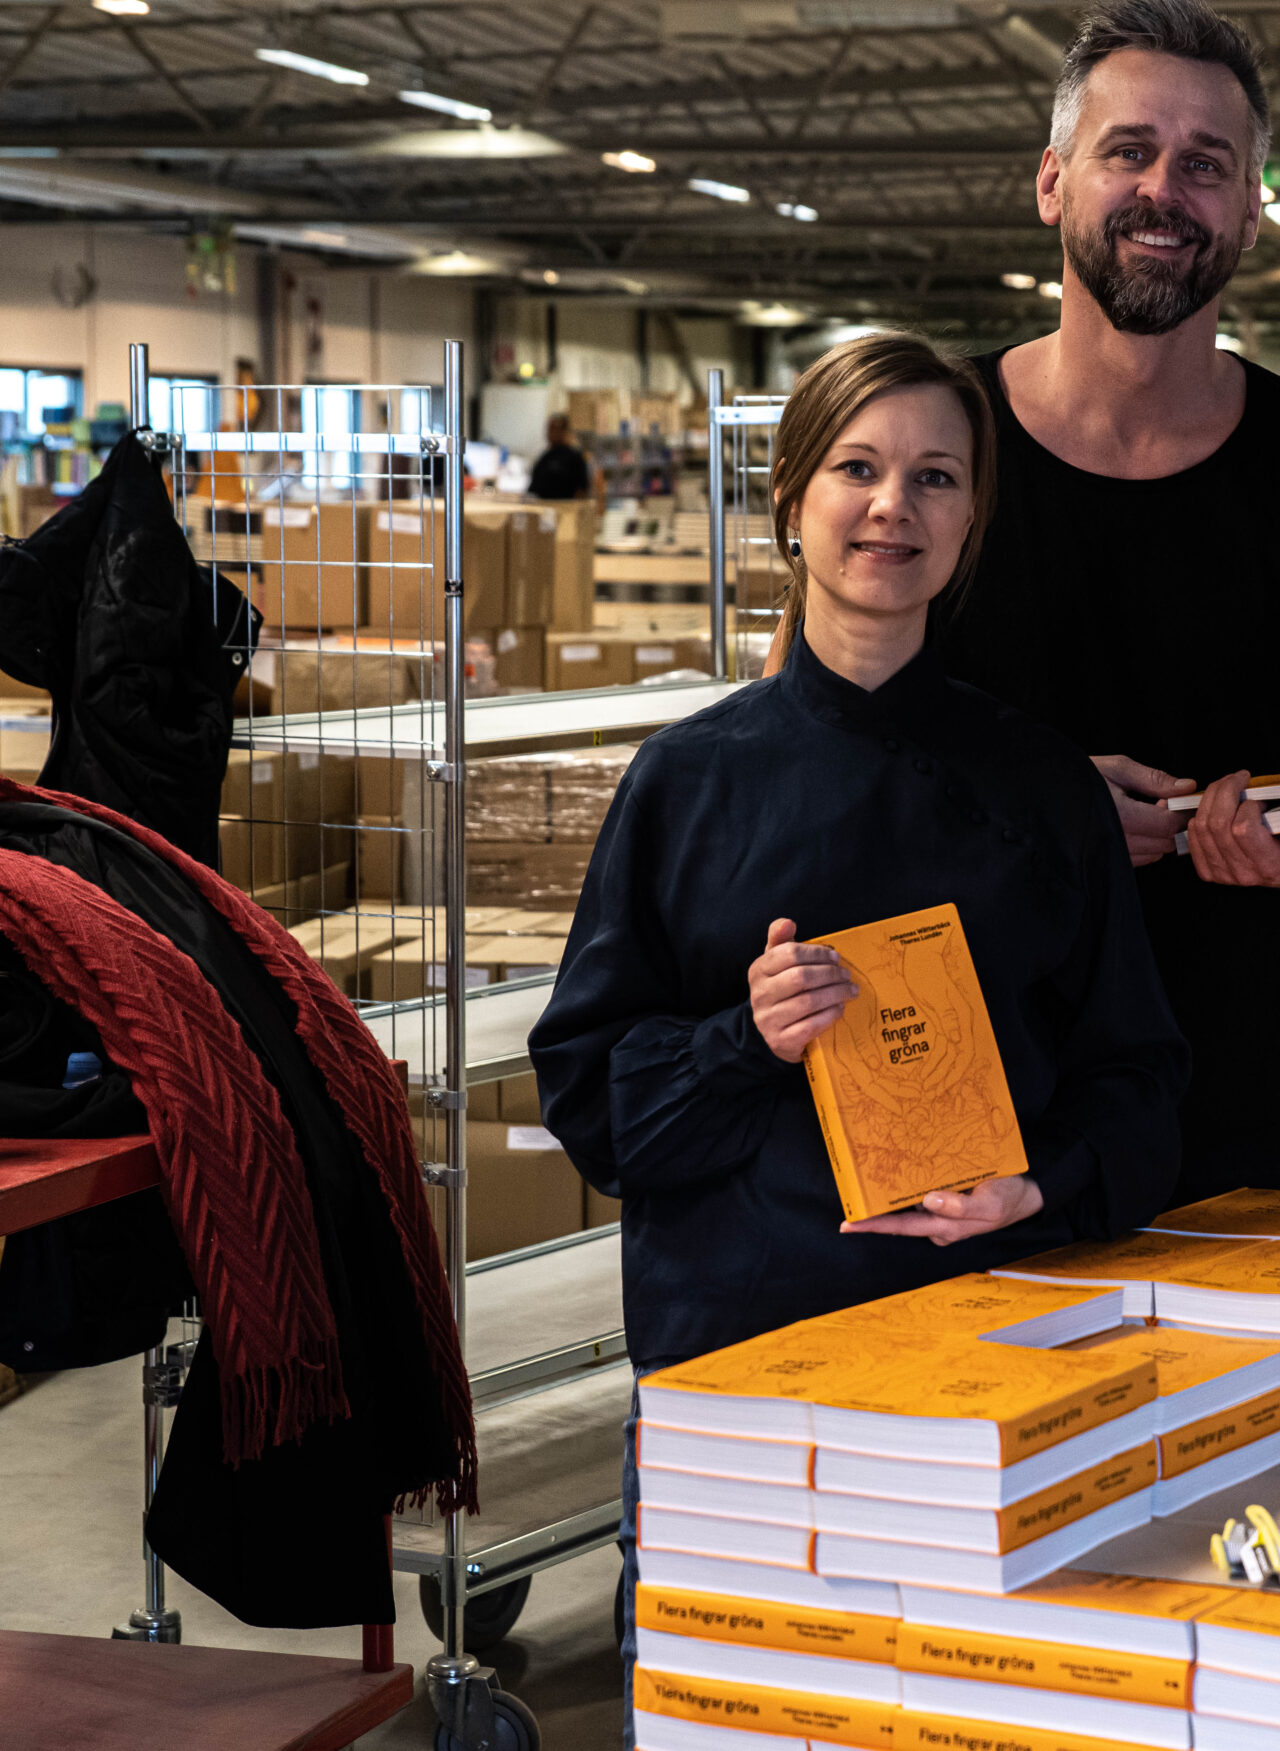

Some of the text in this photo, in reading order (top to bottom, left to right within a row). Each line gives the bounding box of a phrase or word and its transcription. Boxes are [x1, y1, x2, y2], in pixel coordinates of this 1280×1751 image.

[880, 1005, 917, 1024] Flera
[881, 1021, 927, 1043] fingrar
[889, 1040, 930, 1064] gröna
[658, 1601, 763, 1630] Flera fingrar gröna
[921, 1642, 1035, 1671] Flera fingrar gröna
[686, 1692, 723, 1709] fingrar
[725, 1699, 759, 1715] gröna
[920, 1727, 950, 1745] Flera
